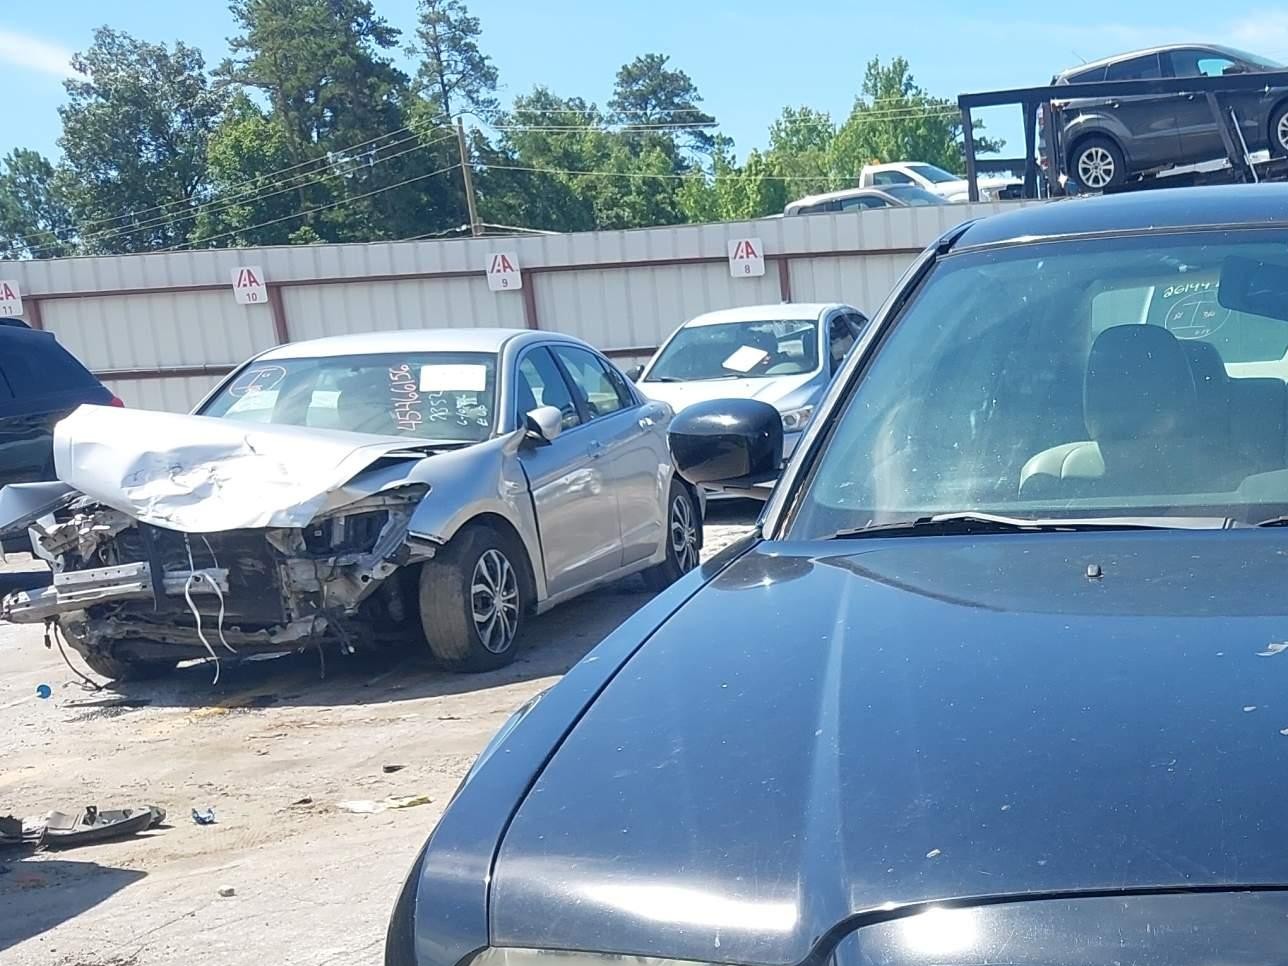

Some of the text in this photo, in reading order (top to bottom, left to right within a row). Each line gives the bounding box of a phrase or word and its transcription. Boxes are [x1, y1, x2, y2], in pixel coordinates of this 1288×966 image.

[744, 264, 751, 274] 8
[502, 279, 508, 287] 9
[246, 293, 258, 302] 10
[2, 306, 13, 315] 11
[388, 363, 423, 432] 45466156
